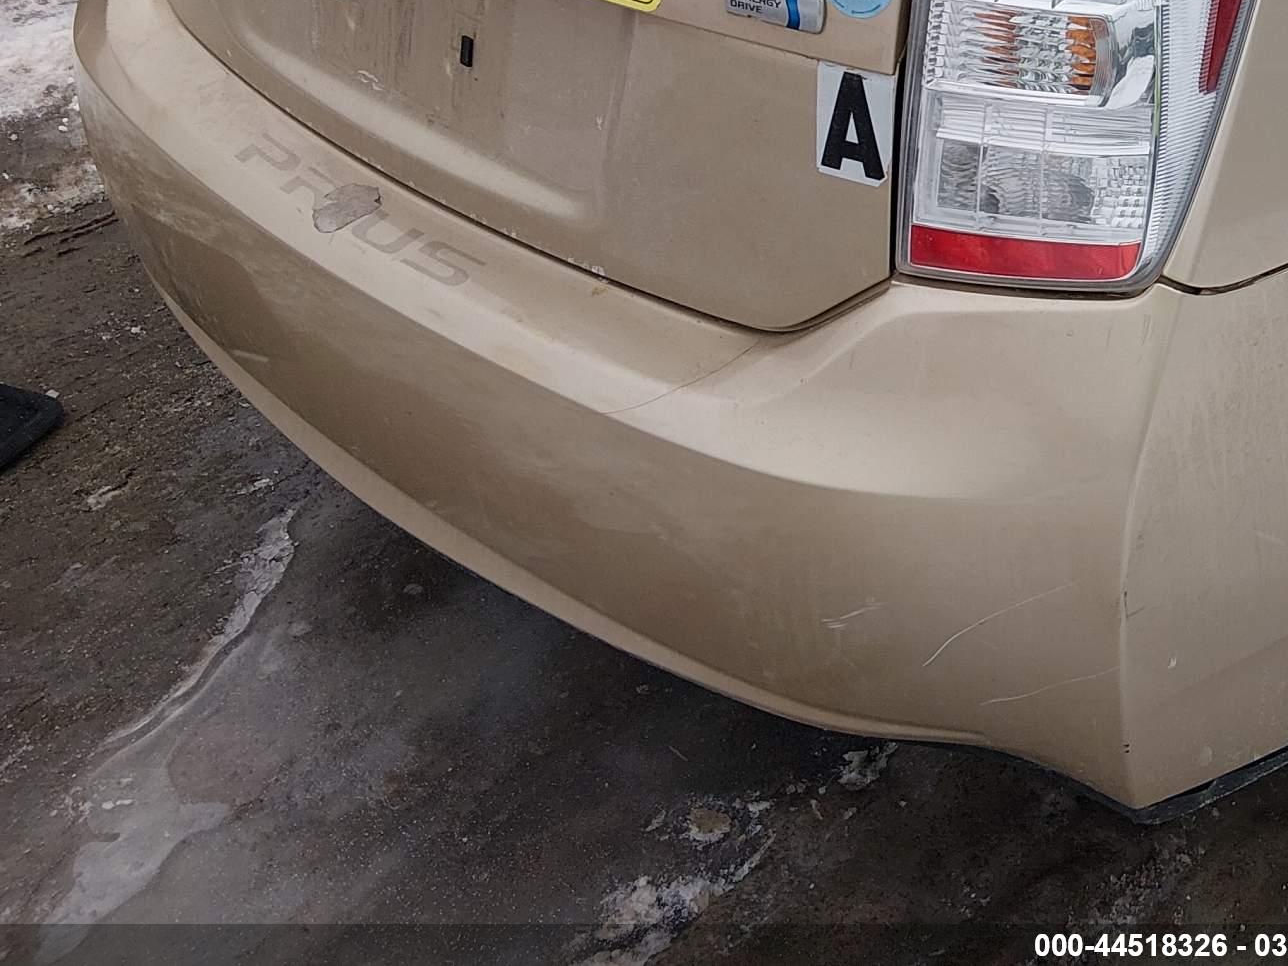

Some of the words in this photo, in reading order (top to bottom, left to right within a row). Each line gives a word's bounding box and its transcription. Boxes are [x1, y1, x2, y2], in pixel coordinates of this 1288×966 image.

[730, 0, 762, 14] DRIVE
[821, 71, 885, 181] A
[234, 132, 486, 287] PRUS
